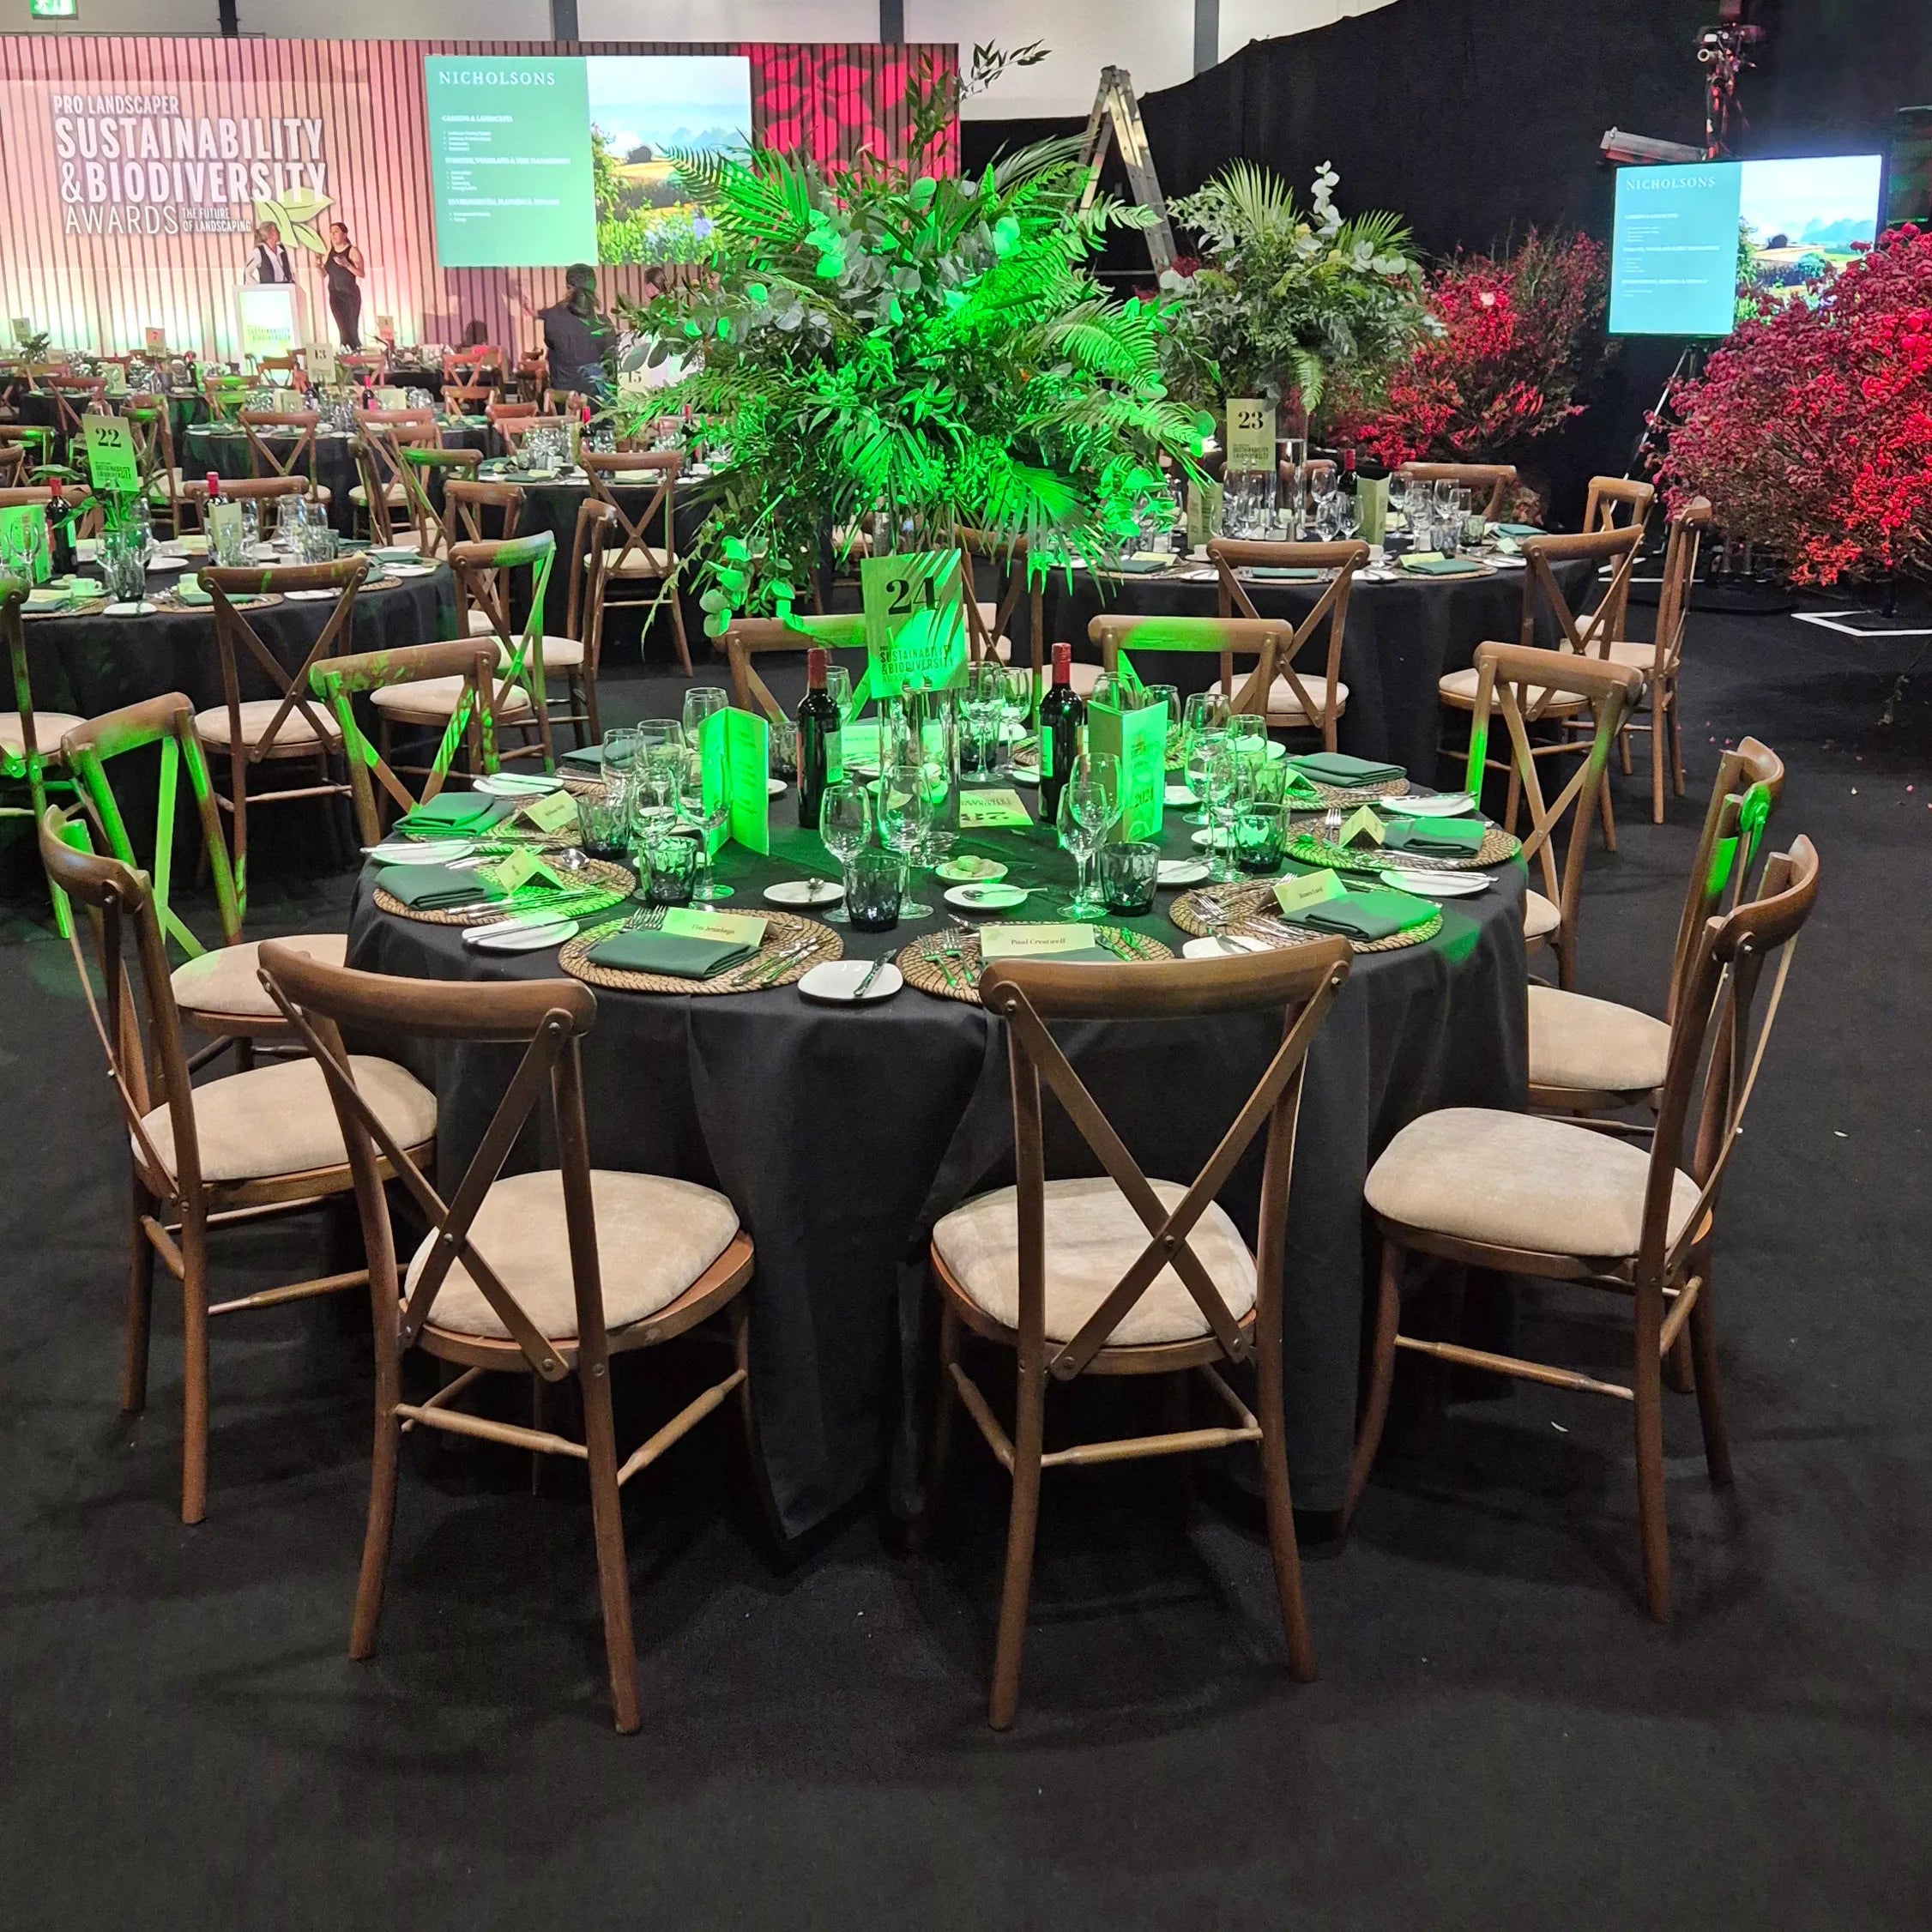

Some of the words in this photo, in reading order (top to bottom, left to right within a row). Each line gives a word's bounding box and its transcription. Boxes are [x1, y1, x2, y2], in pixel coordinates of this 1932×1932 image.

[439, 70, 556, 87] NICHOLSONS
[53, 94, 83, 114] PRO
[88, 95, 179, 115] LANDSCAPER
[54, 117, 323, 160] SUSTAINABILITY
[1626, 177, 1716, 190] NICHOLSONS
[64, 205, 179, 235] AWARDS
[183, 208, 196, 218] THE
[199, 207, 230, 218] FUTURE
[183, 220, 193, 232] OF
[195, 220, 251, 232] LANDSCAPING
[1238, 411, 1264, 429] 23
[95, 427, 122, 448] 22
[885, 577, 940, 615] 24
